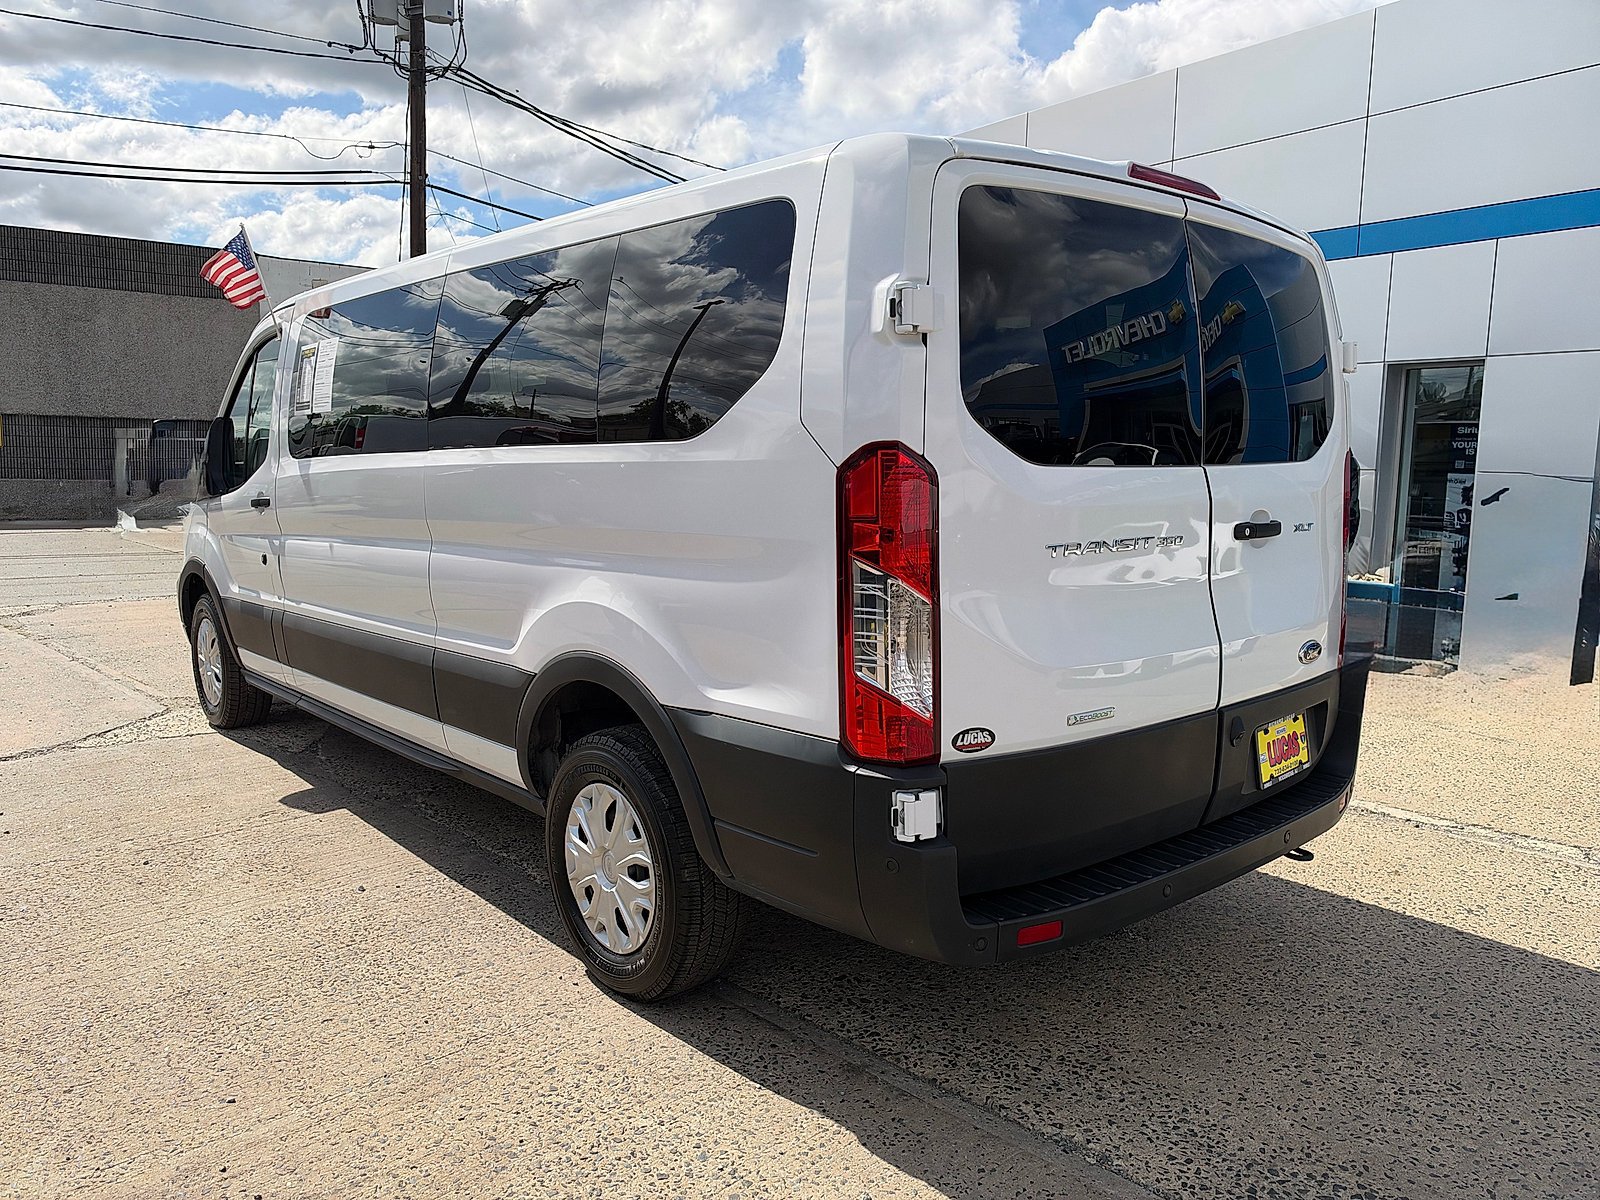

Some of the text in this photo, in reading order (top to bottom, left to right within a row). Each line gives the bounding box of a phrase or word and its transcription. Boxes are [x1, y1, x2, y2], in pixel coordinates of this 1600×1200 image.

[1452, 441, 1477, 449] YOUR
[1045, 536, 1155, 558] TRANSIT
[956, 730, 993, 746] LUCAS
[1266, 730, 1301, 768] LUCAS
